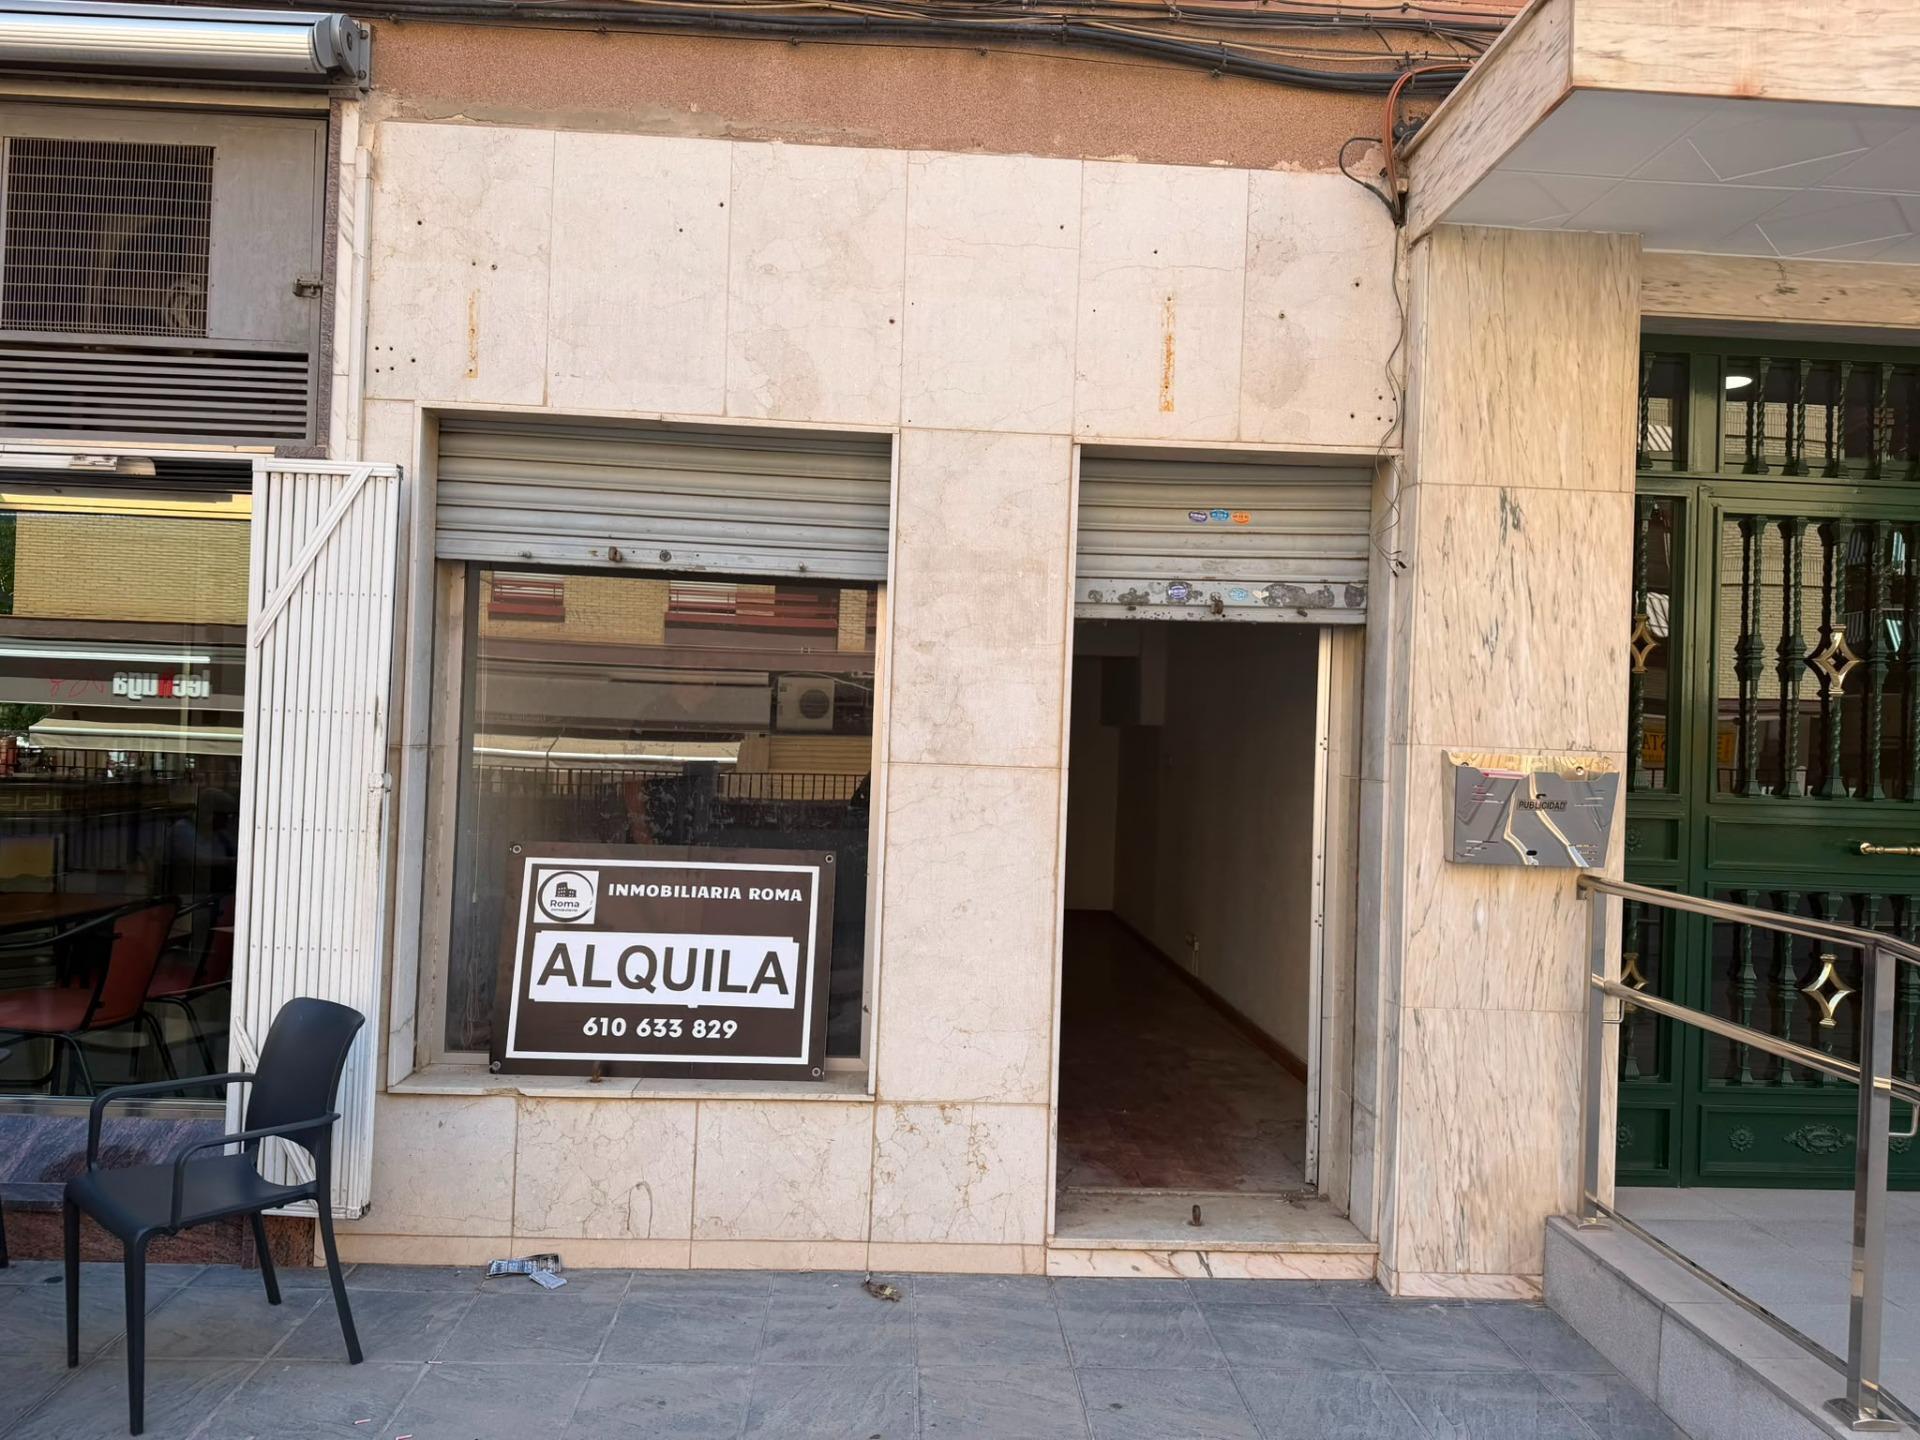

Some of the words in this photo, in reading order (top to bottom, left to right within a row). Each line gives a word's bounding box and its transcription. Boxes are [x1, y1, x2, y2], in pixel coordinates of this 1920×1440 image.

[1518, 800, 1567, 810] PUBLICIDAD
[608, 883, 742, 899] INMOBILIARIA
[749, 887, 803, 901] ROMA
[550, 899, 580, 908] Roma
[536, 942, 789, 995] ALQUILA
[583, 1017, 626, 1037] 610
[636, 1018, 682, 1038] 633
[692, 1019, 738, 1039] 829
